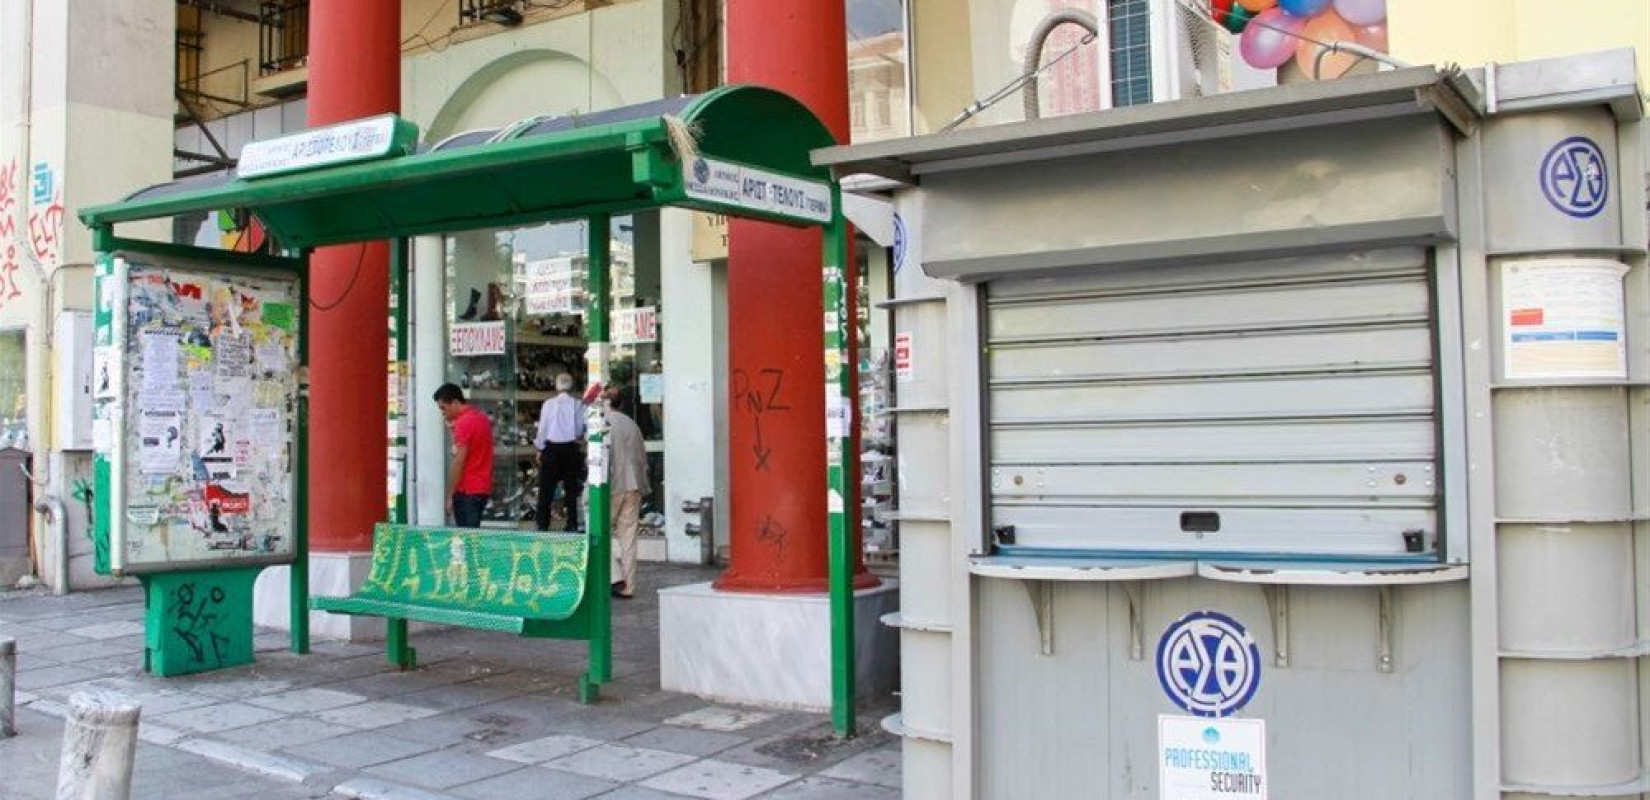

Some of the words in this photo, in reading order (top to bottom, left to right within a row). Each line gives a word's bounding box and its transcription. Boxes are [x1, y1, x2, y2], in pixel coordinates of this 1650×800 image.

[743, 177, 804, 208] ΑΡΙΣΤΤΕΛΟΥΣ
[1164, 747, 1254, 772] PROFESSIONAL
[1210, 771, 1262, 794] SECURITY
